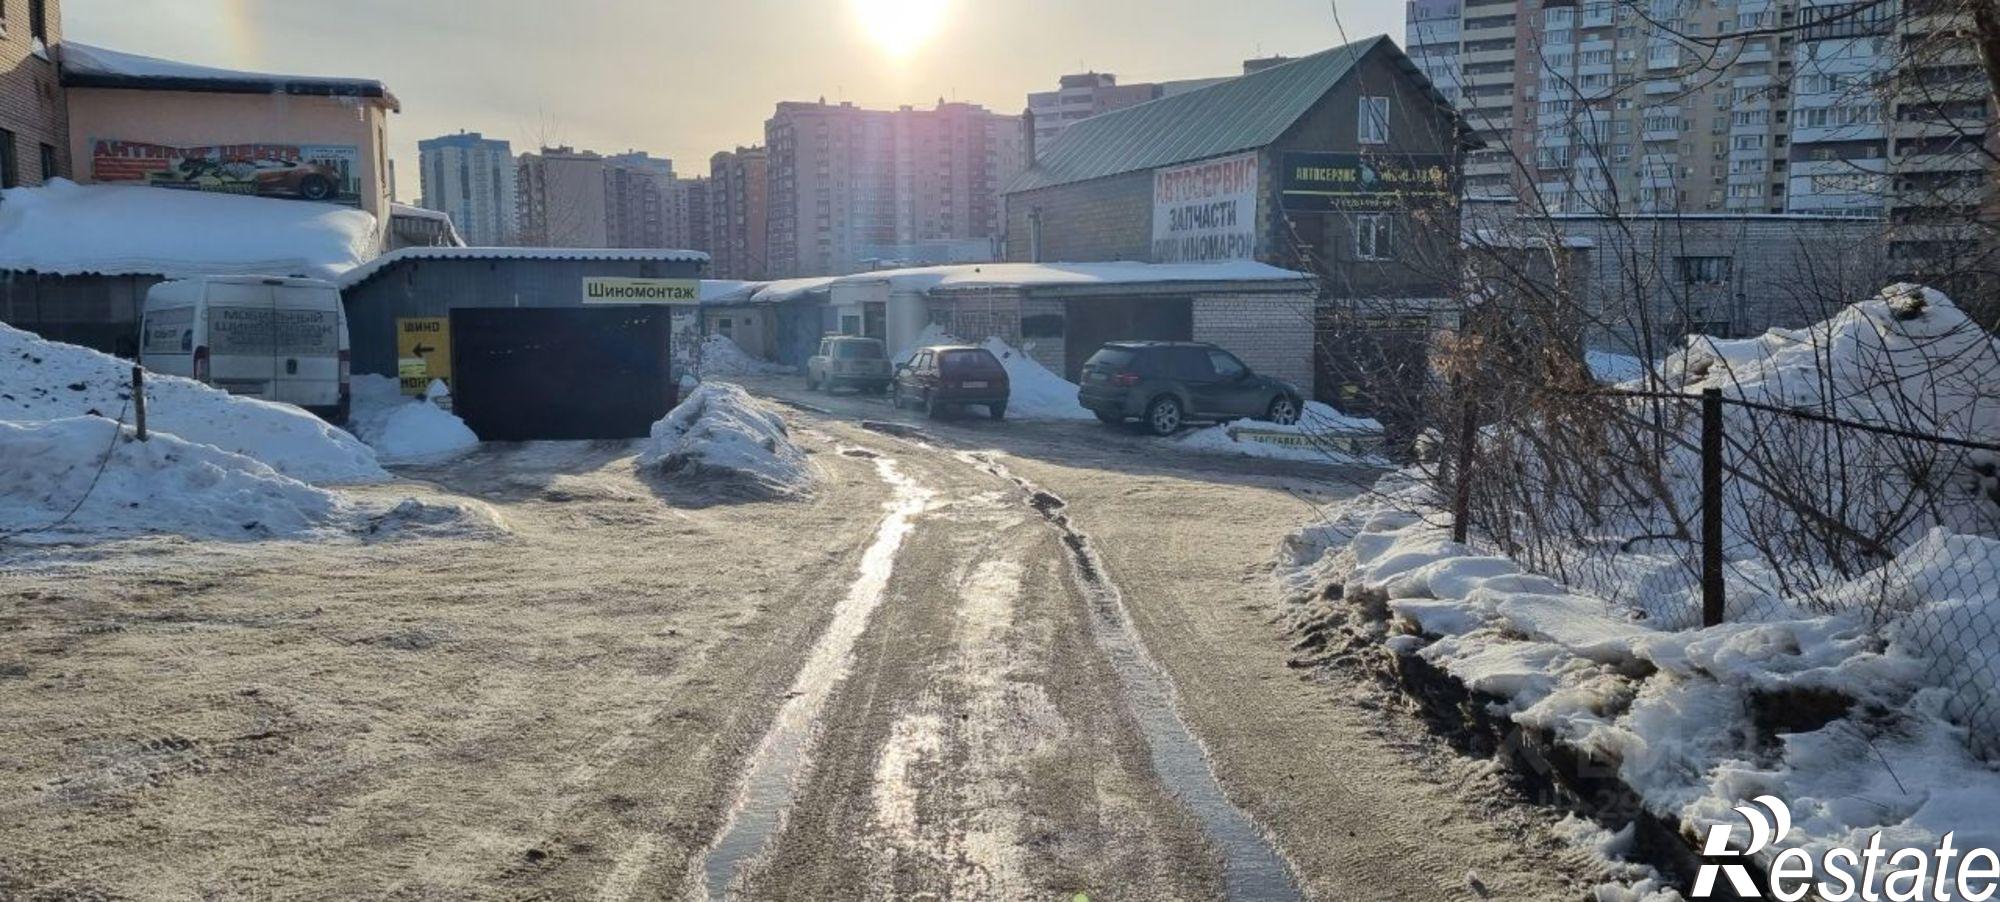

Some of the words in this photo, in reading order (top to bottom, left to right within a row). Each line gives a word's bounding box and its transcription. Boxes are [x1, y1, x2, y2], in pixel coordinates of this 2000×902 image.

[1156, 157, 1257, 204] АВТОСЕРВИС
[1296, 166, 1356, 182] АВТОСЕРВИС
[1169, 200, 1238, 232] ЗАПЧАСТИ
[587, 281, 696, 300] Шиномонтаж
[403, 319, 441, 333] ШИНО
